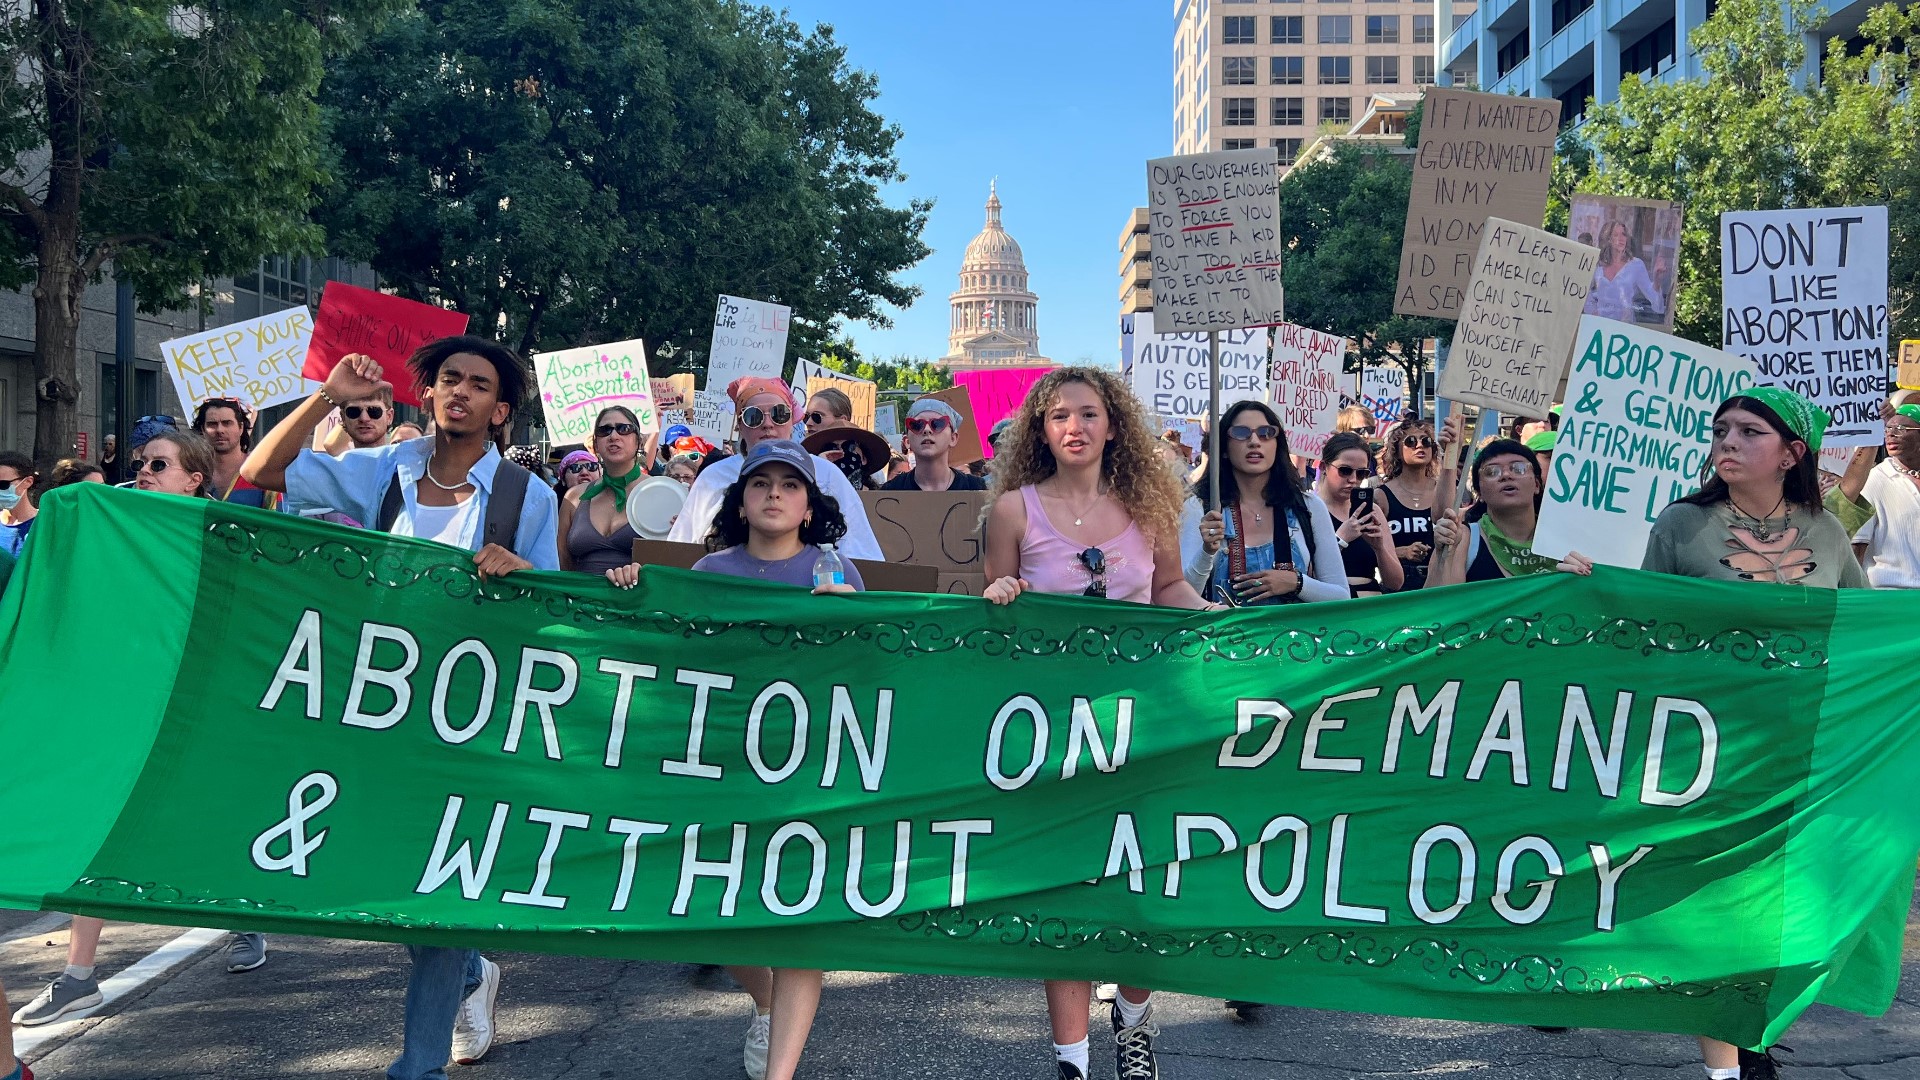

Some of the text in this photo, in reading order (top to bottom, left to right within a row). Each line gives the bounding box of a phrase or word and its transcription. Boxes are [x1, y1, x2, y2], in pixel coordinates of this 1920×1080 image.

[1430, 97, 1554, 133] IF I WANTED
[1419, 140, 1552, 173] GOVERNMENT
[1153, 164, 1190, 185] OUR
[1152, 190, 1166, 206] IS
[1175, 185, 1219, 204] BOLD
[1434, 177, 1498, 205] IN MY
[1151, 205, 1272, 228] TO FORCE YOU
[1153, 227, 1275, 249] TO HAVE A KID
[1421, 216, 1485, 246] WOM
[1729, 216, 1863, 274] DON'T
[1155, 254, 1189, 272] BUT
[1196, 253, 1231, 268] TOO
[1578, 252, 1595, 273] IN
[1157, 276, 1177, 290] TO
[1482, 254, 1588, 300] AMERICA YOU
[1769, 274, 1838, 304] LIKE
[718, 296, 738, 315] Pro
[1156, 288, 1251, 307] MAKE IT TO
[1400, 285, 1417, 308] A
[1473, 280, 1553, 314] CAN STILL
[715, 314, 737, 329] Life
[761, 306, 786, 332] LIE
[1172, 307, 1282, 328] RECESS ALIVE
[1724, 304, 1887, 346] ABORTION?
[170, 312, 313, 380] KEEP YOUR
[1282, 323, 1341, 356] TAKE AWAY
[1530, 344, 1544, 360] IF
[185, 345, 304, 401] LAWS OFF
[1303, 351, 1323, 370] MY
[1465, 348, 1547, 380] YOU GET
[1739, 351, 1815, 377] NORE
[1821, 346, 1884, 374] THEM
[1155, 369, 1175, 390] IS
[1273, 360, 1301, 384] BIRTH
[1303, 368, 1338, 393] CONTROL
[1364, 368, 1403, 387] The US
[1468, 370, 1550, 407] PREGNANT
[1828, 374, 1887, 398] IGNORE
[1294, 386, 1329, 411] BREED
[1378, 385, 1388, 397] in
[1285, 406, 1317, 429] MORE
[1574, 381, 1713, 444] & GENDE
[1557, 416, 1682, 473] AFFIRMING
[1548, 452, 1636, 514] SAVE
[258, 608, 1721, 807] ABORTION ON DEMAND
[248, 769, 1654, 933] & WITHOUT APOLOGY
